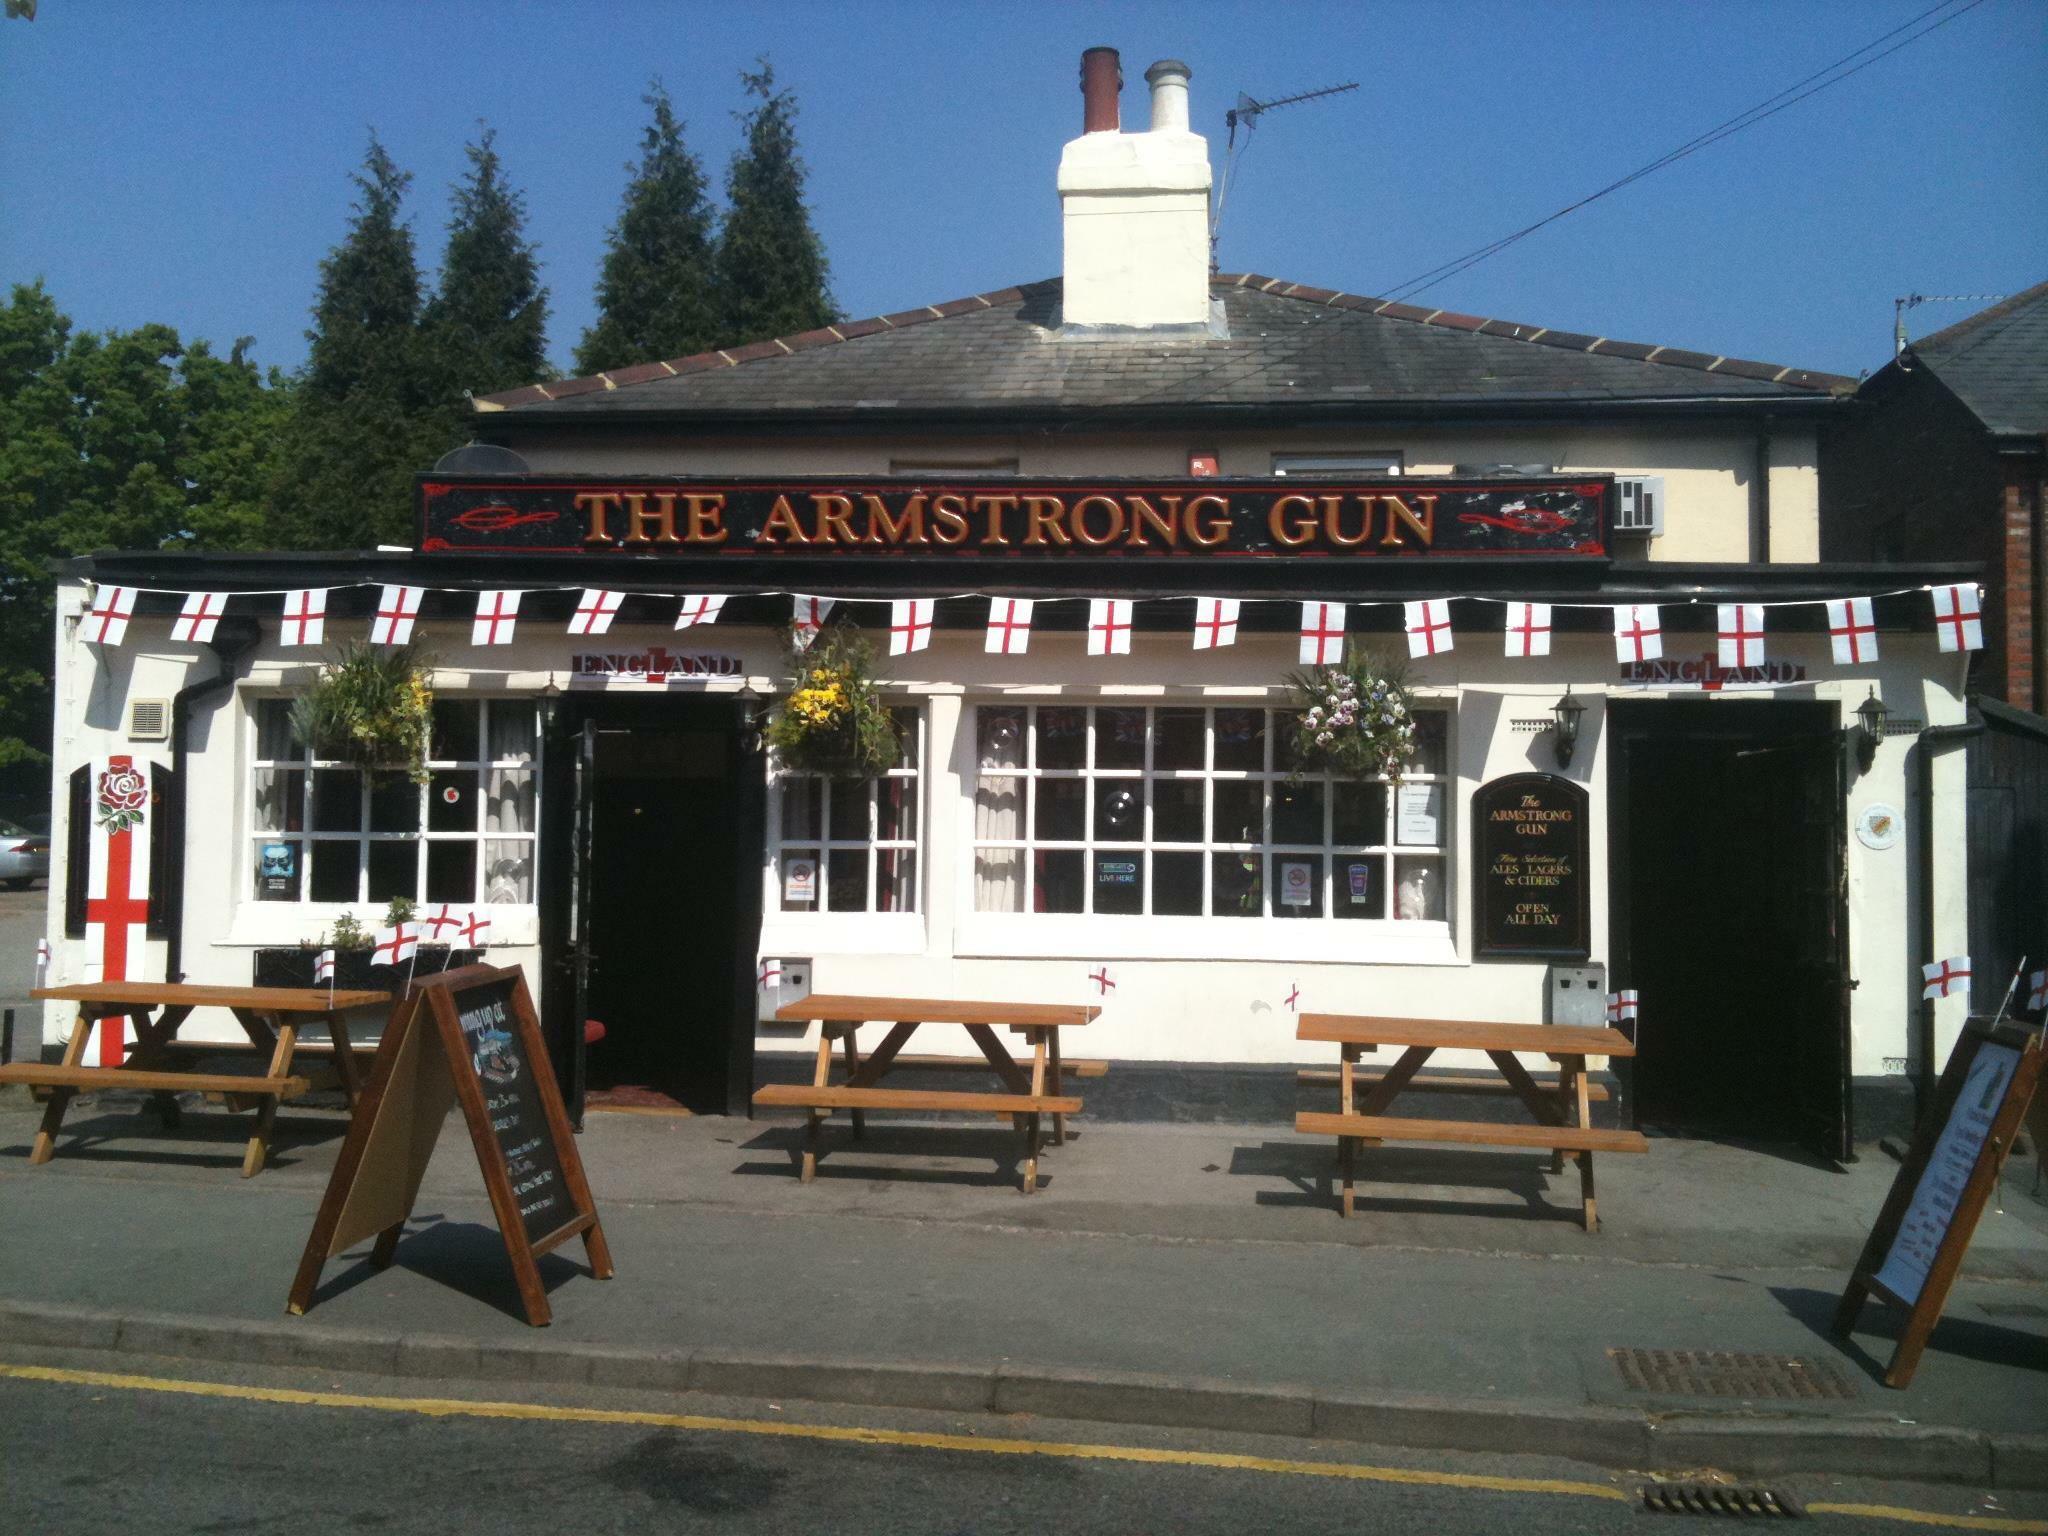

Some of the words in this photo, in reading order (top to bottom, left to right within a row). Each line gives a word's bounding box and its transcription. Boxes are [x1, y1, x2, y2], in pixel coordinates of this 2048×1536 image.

[573, 492, 727, 545] THE
[757, 492, 1233, 546] ARMSTRONG
[1267, 494, 1438, 546] GUN
[579, 653, 736, 676] ENGLAND
[1629, 659, 1798, 684] ENGLAND
[1521, 795, 1540, 807] The
[1490, 810, 1572, 821] ARMSTRONG
[1516, 824, 1547, 835] GUN
[1491, 865, 1519, 874] ALES
[1528, 865, 1572, 875] LAGERS
[1504, 875, 1516, 886] &
[1518, 875, 1561, 886] CIDERS
[1516, 904, 1549, 913] OPEN
[1504, 913, 1527, 925] ALL
[1533, 913, 1561, 925] DAY
